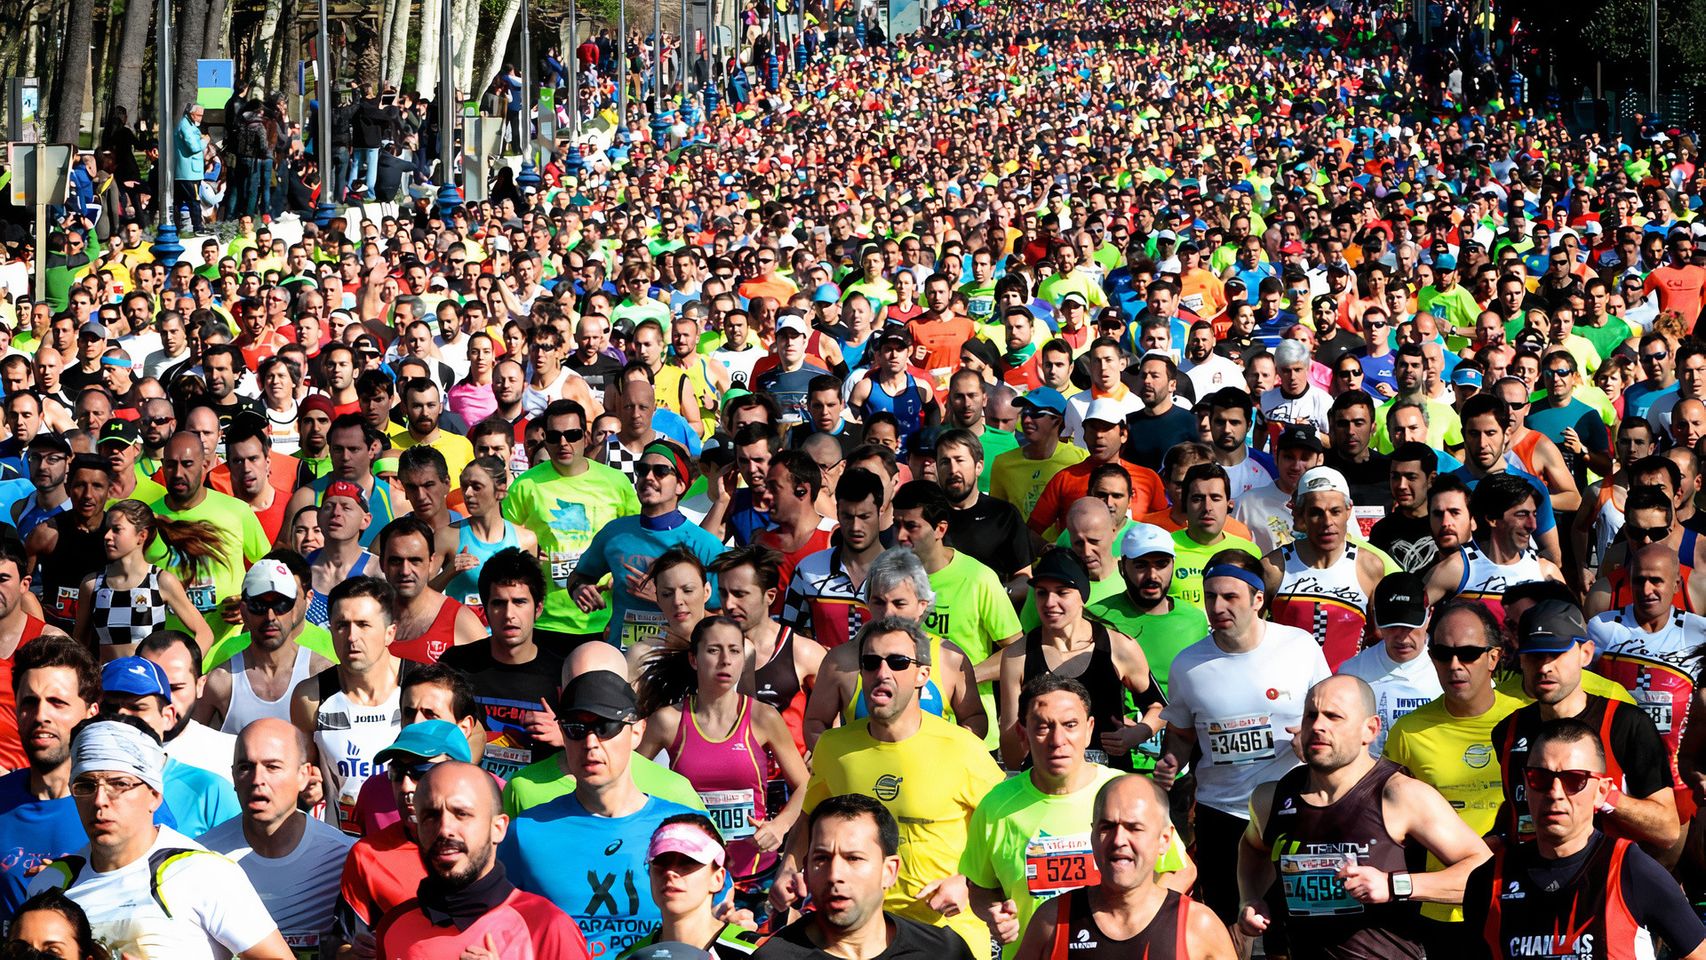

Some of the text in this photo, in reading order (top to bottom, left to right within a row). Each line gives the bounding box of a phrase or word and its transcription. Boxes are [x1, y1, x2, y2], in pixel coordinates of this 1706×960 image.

[1218, 731, 1263, 754] 3496
[1046, 856, 1087, 882] 523
[583, 869, 640, 917] XI
[1294, 875, 1347, 902] 4598
[578, 919, 662, 934] ARATONA
